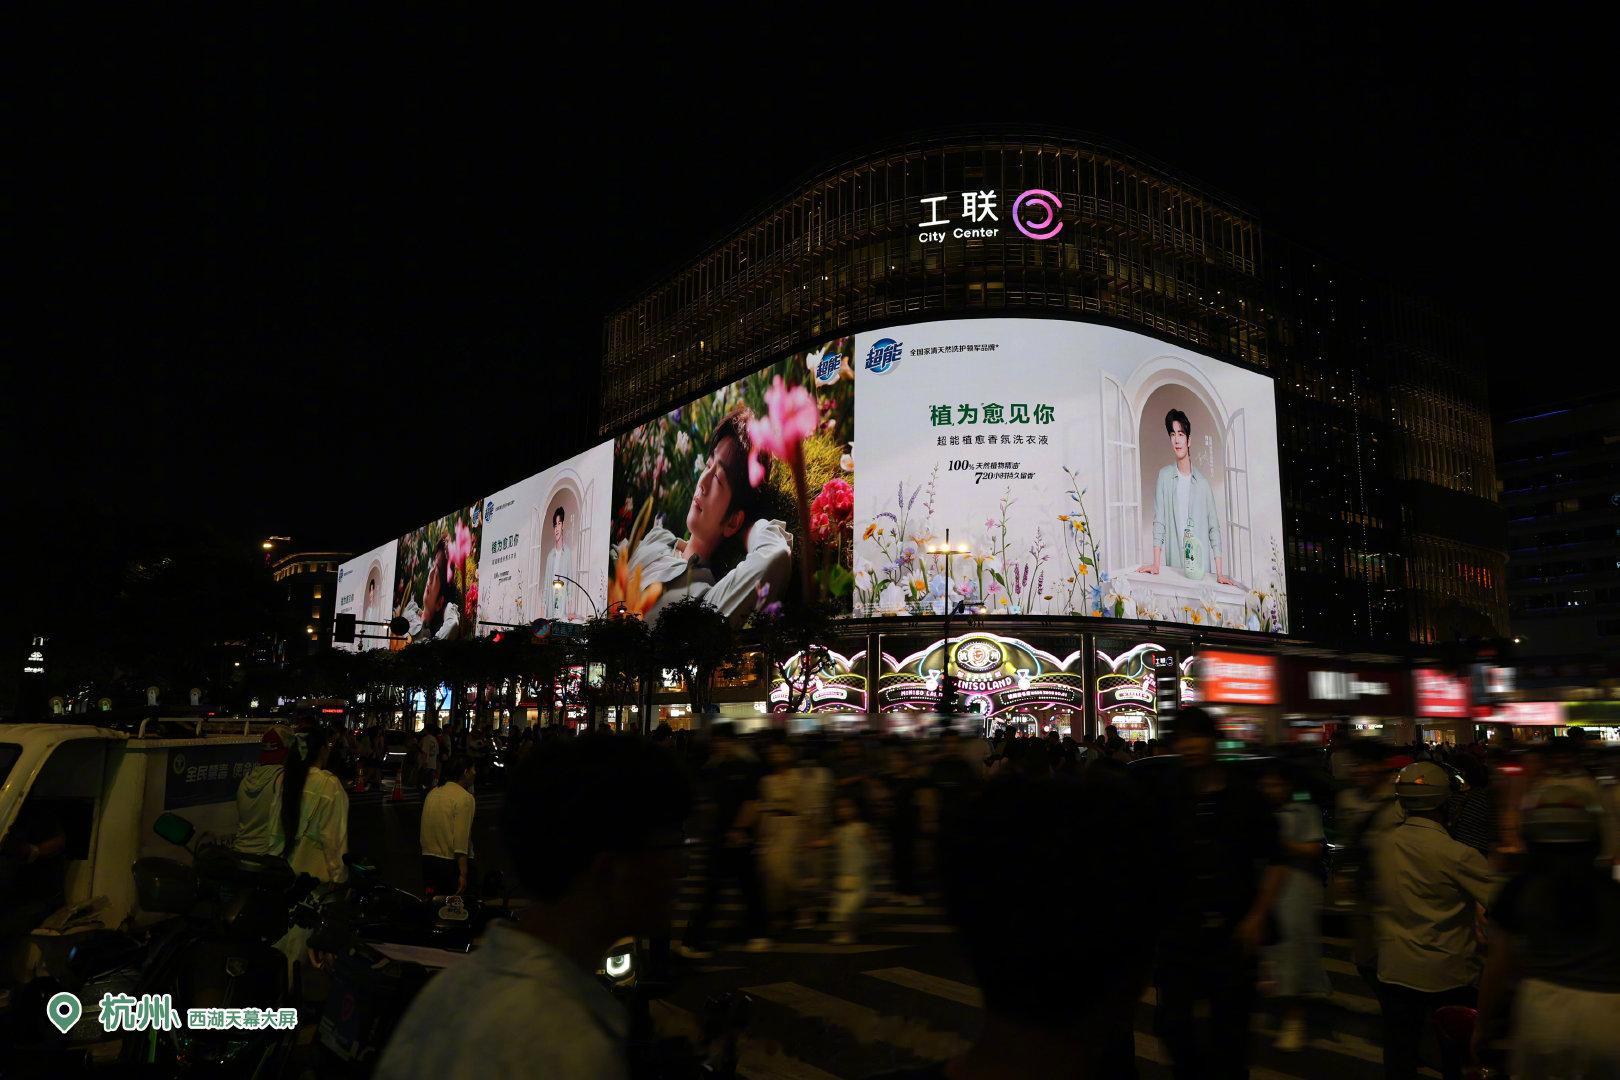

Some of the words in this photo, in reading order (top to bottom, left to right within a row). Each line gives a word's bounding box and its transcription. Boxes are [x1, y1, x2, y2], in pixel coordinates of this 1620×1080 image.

[918, 190, 999, 228] 工联
[918, 231, 946, 243] City
[953, 227, 999, 239] Center
[815, 352, 843, 378] 超能
[864, 341, 904, 370] 超能
[936, 434, 1049, 446] 超能植愈香氛洗衣液
[986, 676, 1012, 690] LAND
